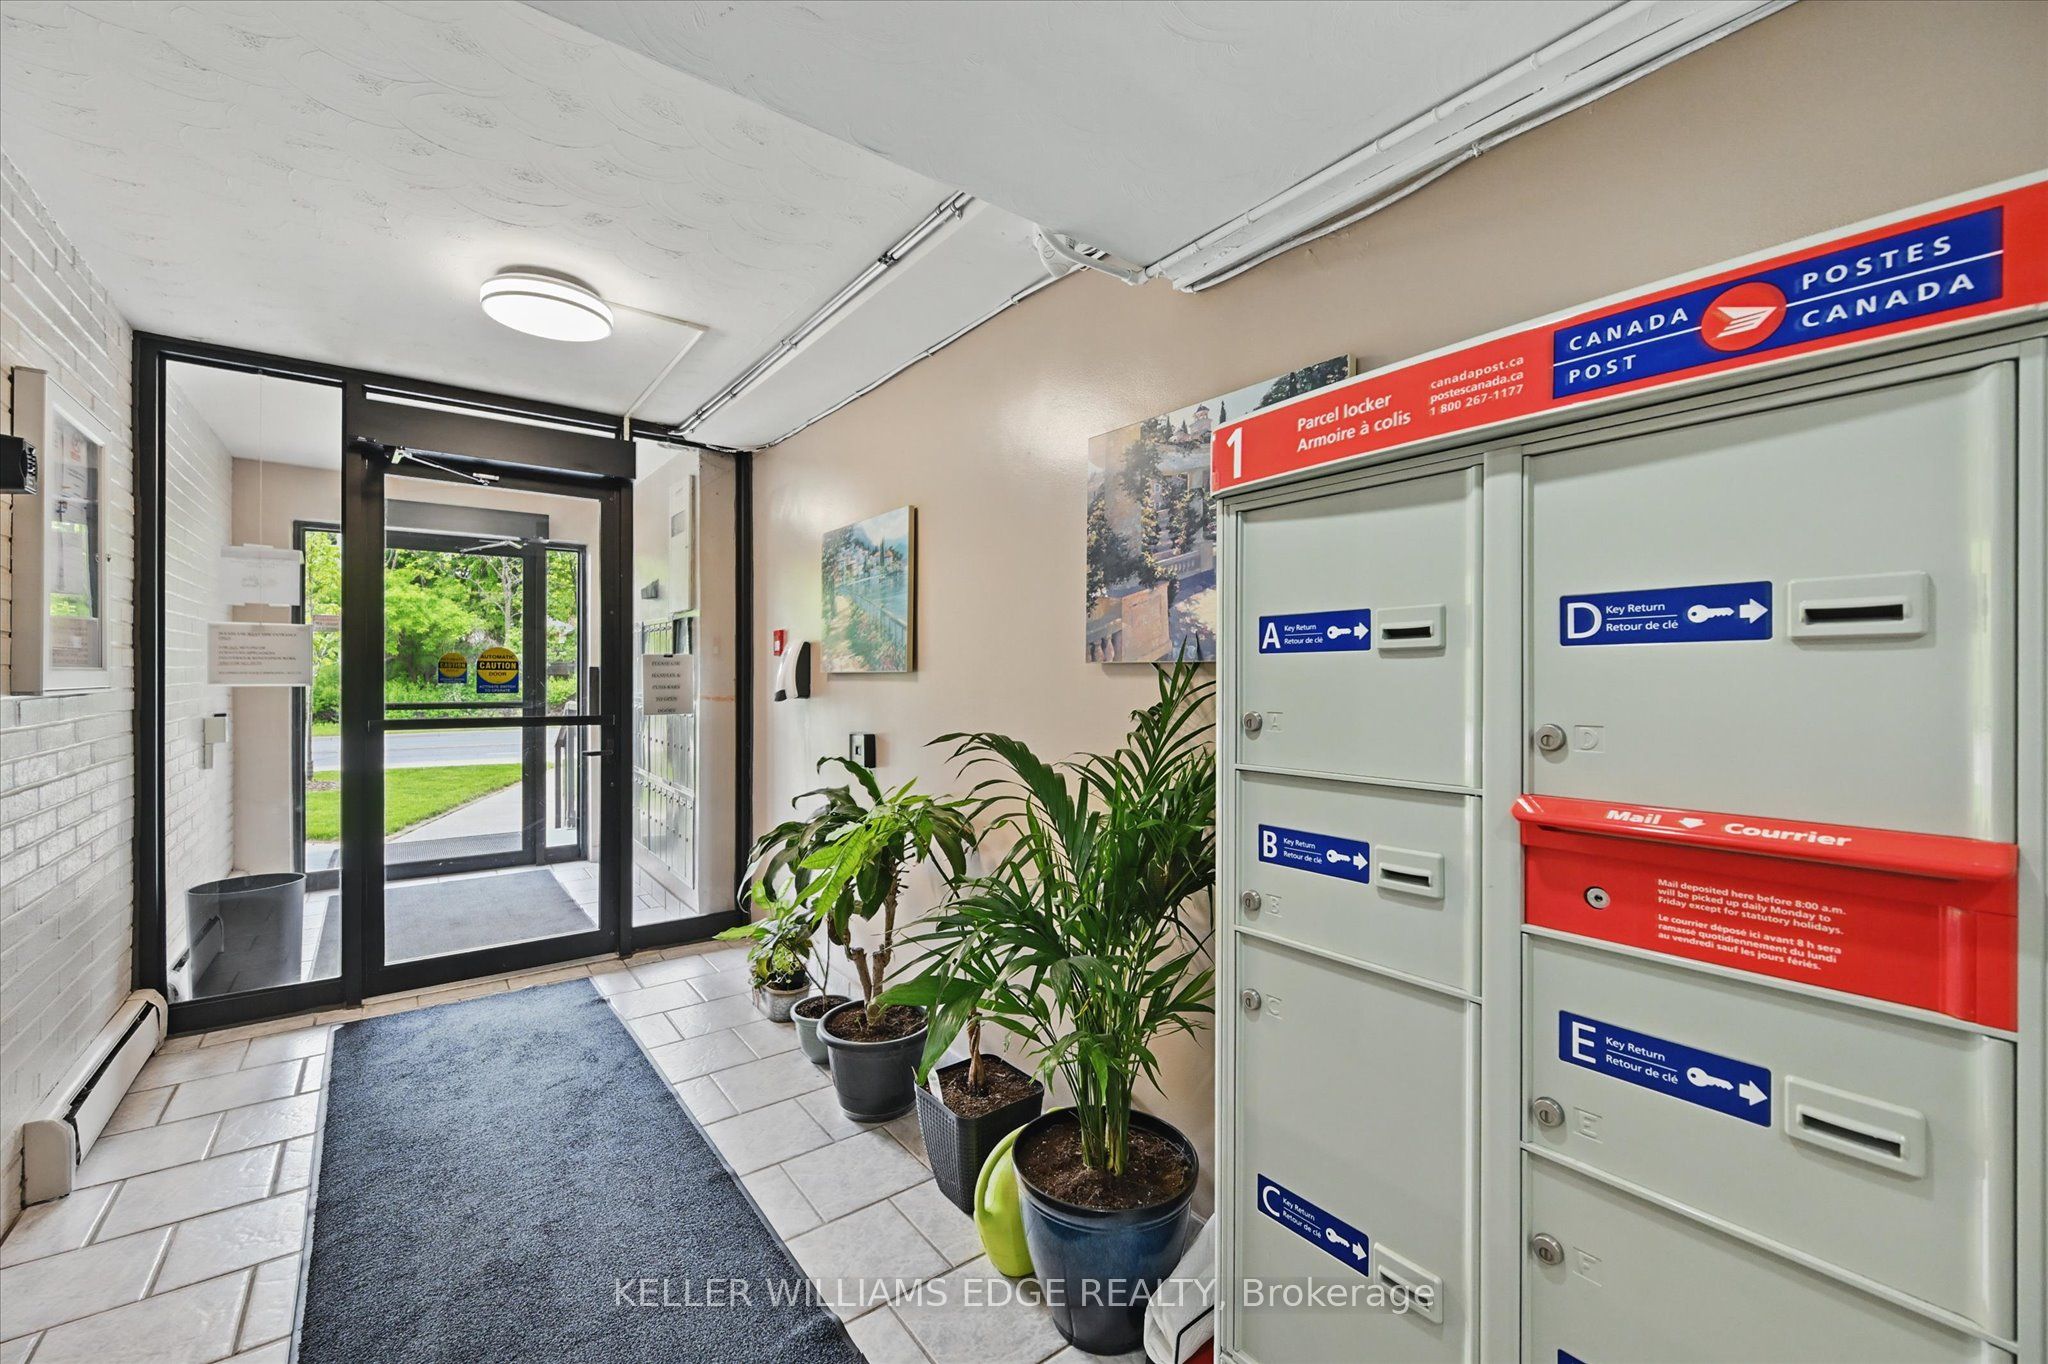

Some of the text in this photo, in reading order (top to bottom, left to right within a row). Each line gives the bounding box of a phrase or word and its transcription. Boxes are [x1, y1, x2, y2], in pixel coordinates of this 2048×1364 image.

[1802, 235, 1951, 290] POSTES
[1802, 273, 1975, 328] CANADA
[1569, 307, 1689, 351] CANADA
[1430, 356, 1524, 389] canadapost.ca
[1568, 354, 1637, 384] POST
[1429, 371, 1524, 405] postescanada.ca
[1430, 384, 1524, 416] 1 800 267-1177
[1297, 394, 1392, 432] Parcel locker
[1296, 410, 1411, 453] Armoire à colis
[1226, 427, 1243, 480] 1
[1567, 601, 1602, 640] D
[1605, 604, 1665, 616] Key Return
[1606, 620, 1678, 632] Retour de clé
[1261, 622, 1281, 649] A
[1314, 636, 1323, 644] clé
[480, 662, 517, 670] CAUTION
[1263, 830, 1278, 858] B
[1283, 838, 1316, 850] Key Return
[1605, 810, 1852, 847] Mail Courrier
[1283, 850, 1304, 860] Retour
[1313, 856, 1322, 864] clé
[1658, 878, 1846, 915] Mail deposited here before 8:00 a.m.
[1658, 888, 1832, 922] will be picked up daily Monday to
[1658, 896, 1844, 935] Friday except for statutory holidays.
[1658, 914, 1842, 954] Le courrier déposé ici avant 8 h sera
[1658, 924, 1837, 963] ramassé quotidiennement du lundi
[1658, 932, 1822, 970] au vendredi sauf les jours fériés.
[1572, 1020, 1597, 1064] E
[1605, 1036, 1666, 1062] Key Return
[1606, 1054, 1678, 1085] Retour de clé
[1262, 1185, 1280, 1218] C
[1282, 1197, 1316, 1222] Key Return
[1282, 1210, 1322, 1239] Retour de clé
